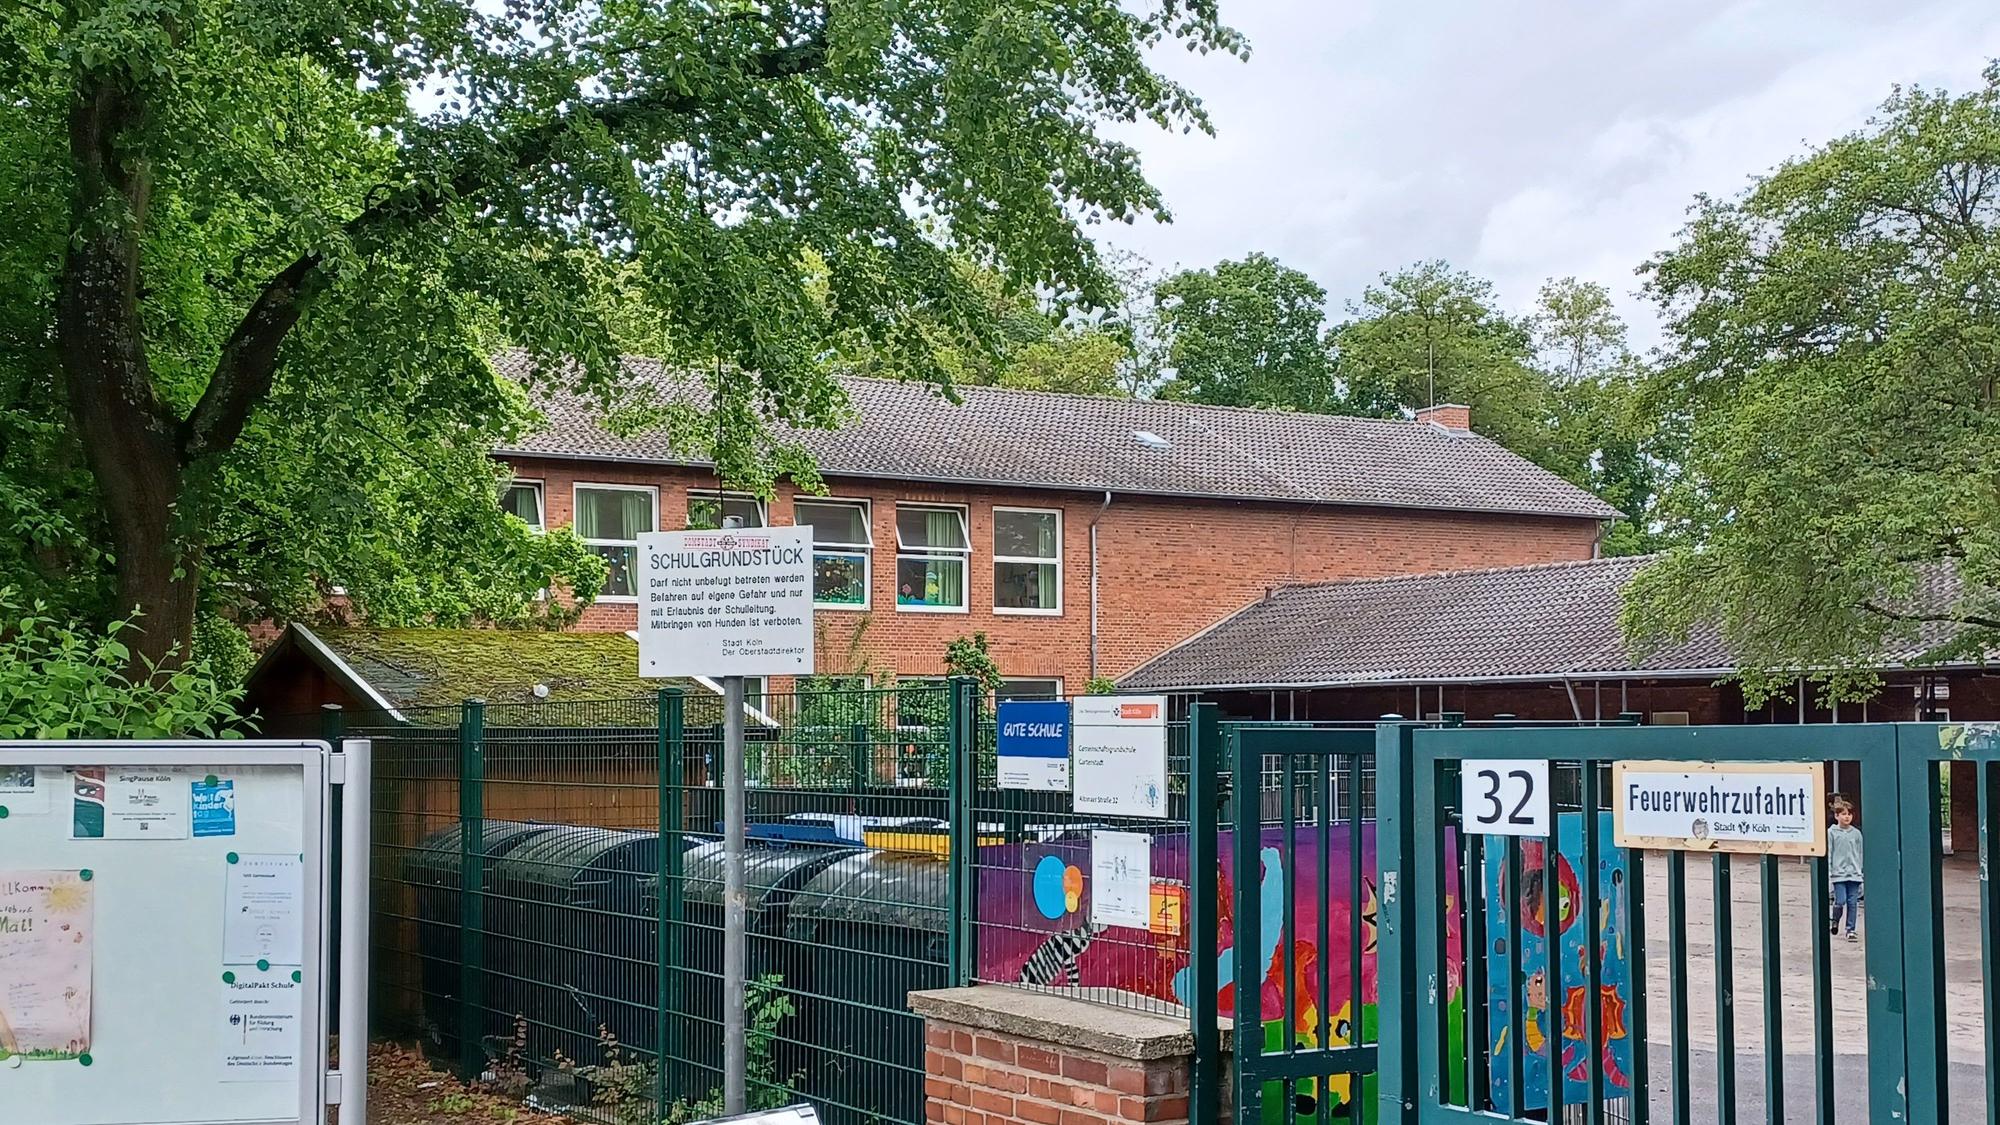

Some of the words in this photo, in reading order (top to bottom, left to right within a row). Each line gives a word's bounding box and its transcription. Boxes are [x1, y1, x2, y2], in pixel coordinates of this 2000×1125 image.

[651, 545, 803, 569] SCHULGRUNDSTÜCK
[650, 577, 668, 588] Darf
[672, 577, 692, 587] nicht
[695, 576, 731, 587] unbefugt
[735, 575, 771, 585] betreten
[774, 573, 805, 583] werden
[650, 592, 688, 602] Befahren
[691, 591, 704, 601] auf
[708, 591, 735, 602] eigene
[739, 589, 767, 599] Gefahr
[770, 588, 786, 598] und
[790, 589, 803, 597] nur
[650, 607, 663, 616] mit
[667, 606, 704, 616] Erlaubnis
[708, 605, 721, 615] der
[725, 604, 777, 615] Schulleitung.
[650, 620, 693, 631] Mitbringen
[697, 620, 712, 628] von
[715, 618, 746, 628] Hunden
[749, 617, 760, 627] ist
[763, 616, 803, 627] verboten.
[722, 639, 743, 647] Stadt
[722, 648, 735, 656] Der
[1003, 722, 1027, 737] GUTE
[1027, 722, 1064, 738] SCHULE
[1477, 769, 1535, 825] 32
[1629, 784, 1806, 816] Feuerwehrzufahrt
[1713, 821, 1736, 832] Stadt
[230, 982, 270, 990] DigitalPakt
